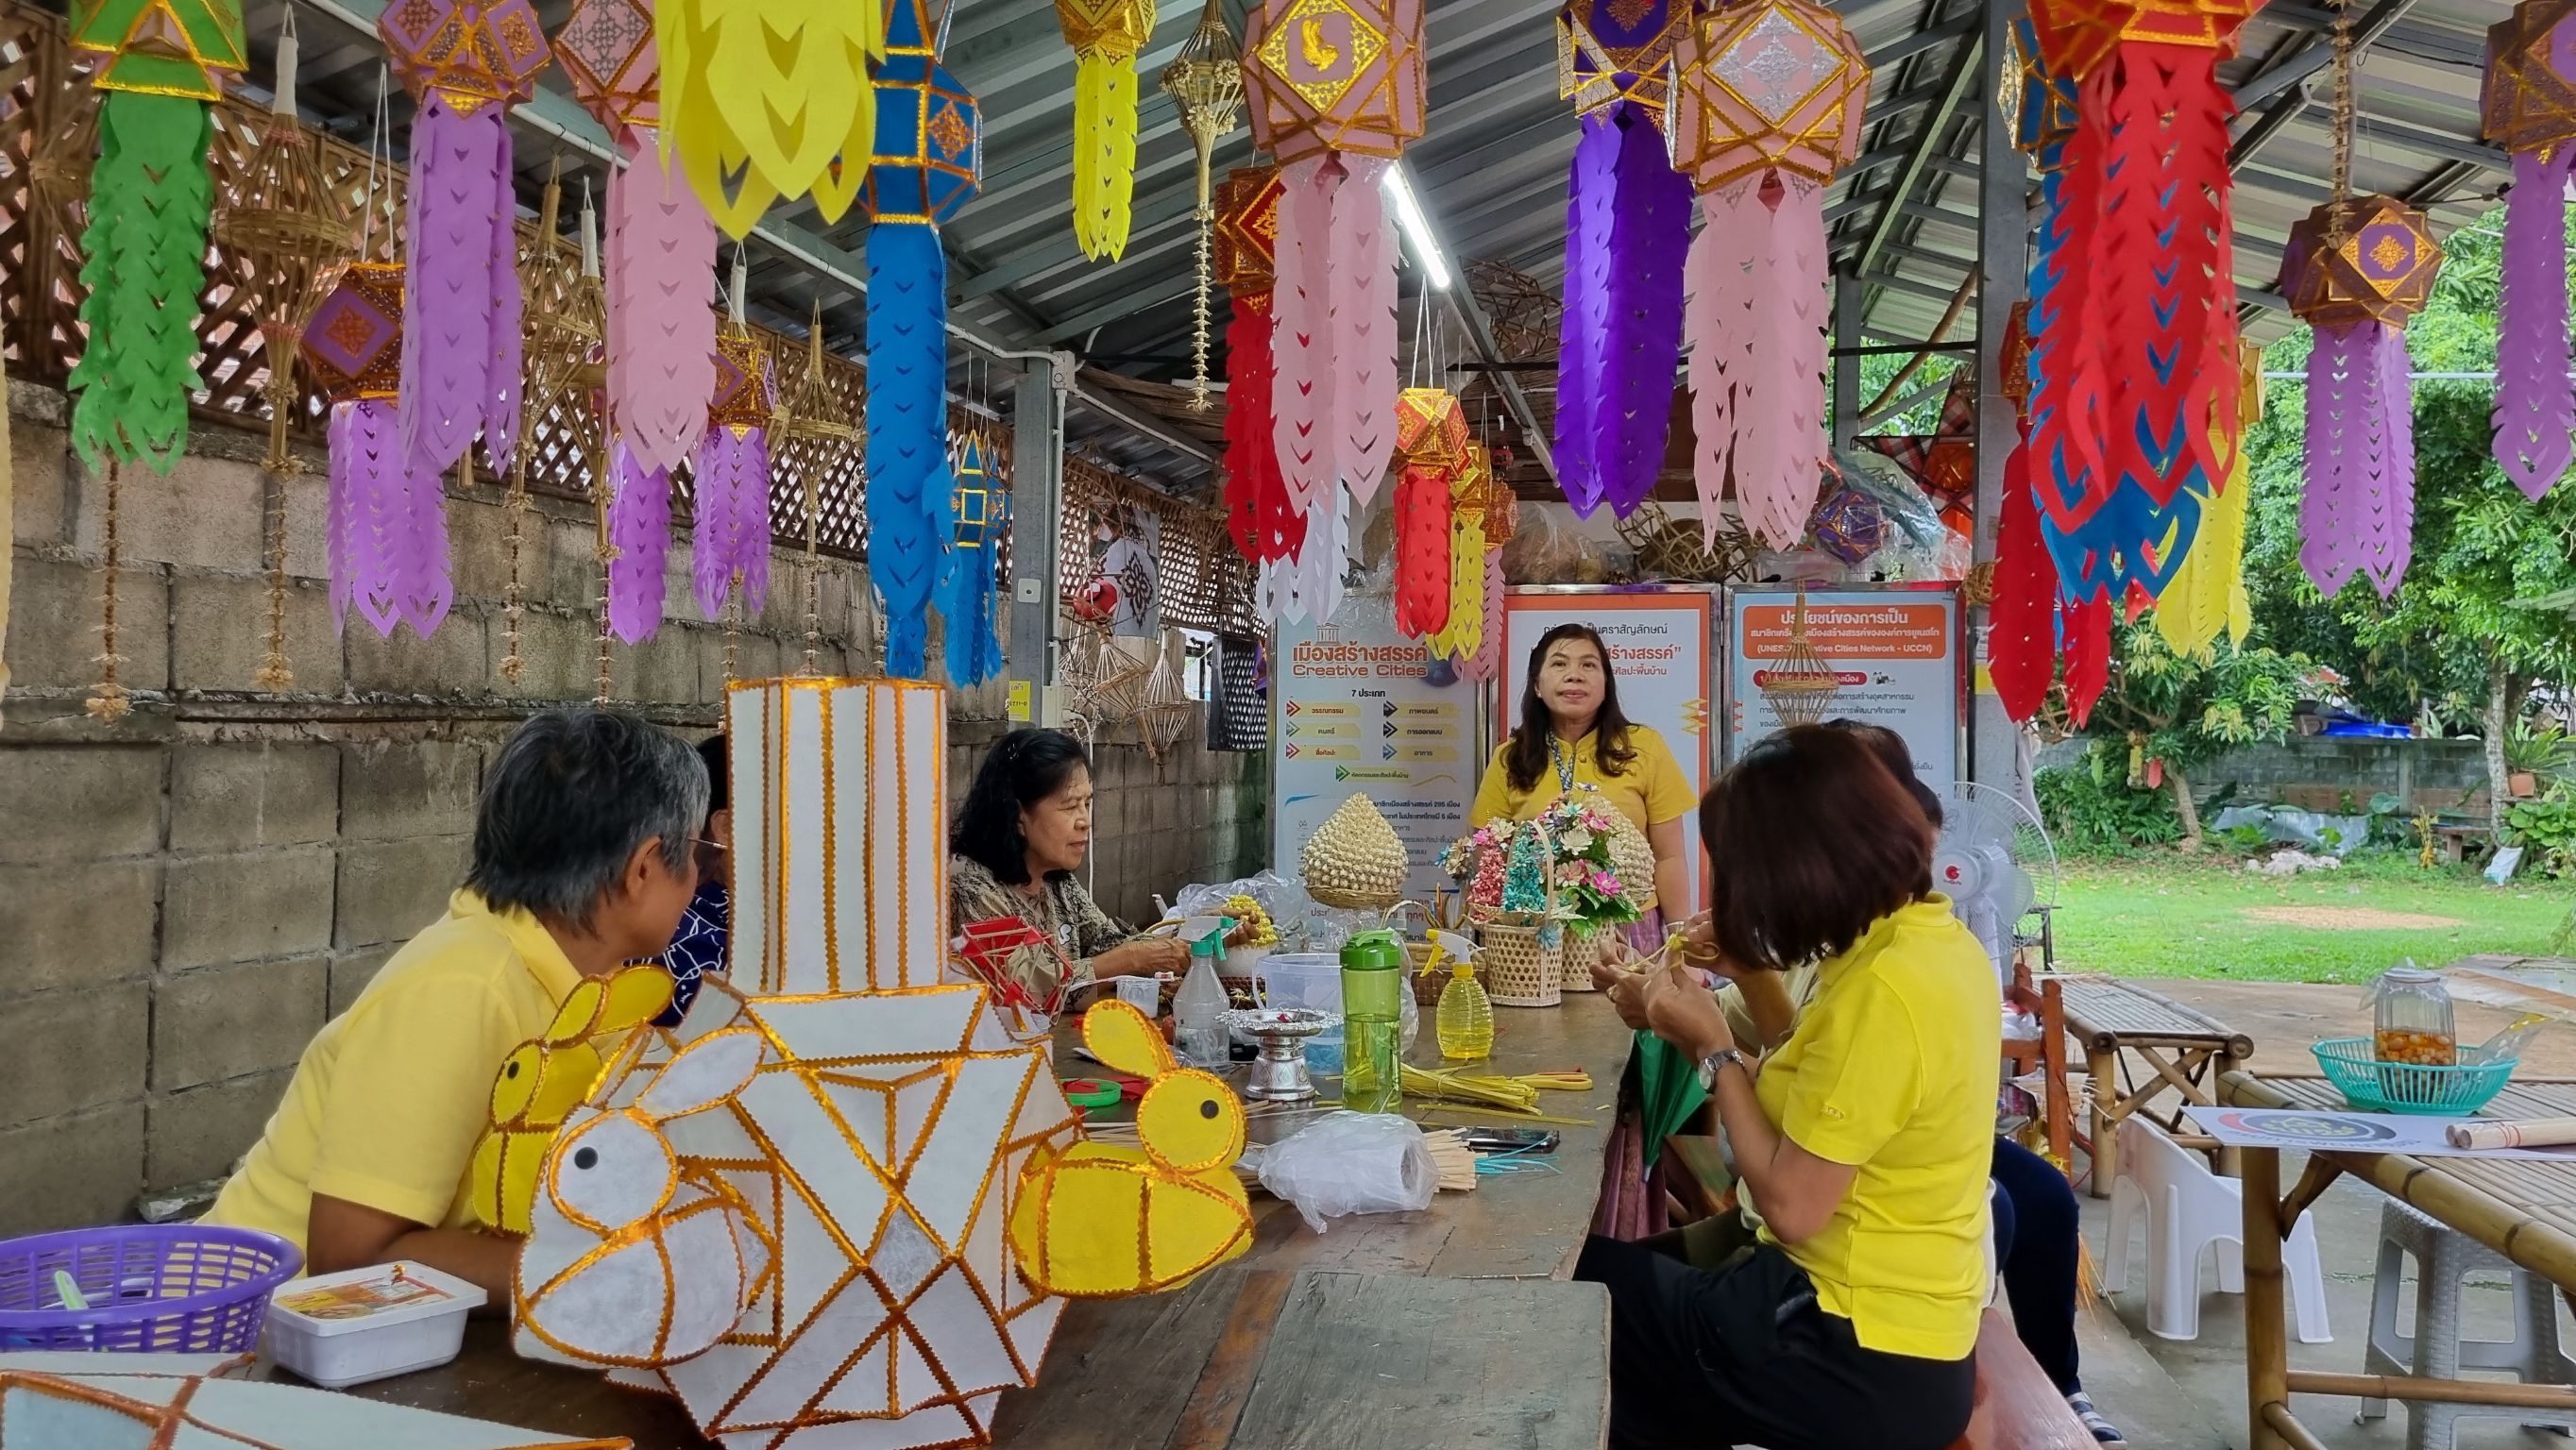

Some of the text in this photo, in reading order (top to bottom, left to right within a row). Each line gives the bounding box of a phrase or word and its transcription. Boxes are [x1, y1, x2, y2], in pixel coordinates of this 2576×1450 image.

[1781, 608, 1908, 625] ปรโยชน์ของการเป็น
[1293, 641, 1428, 662] เมืองสร้างสรรค์
[1835, 643, 1859, 652] Cities
[1860, 643, 1895, 652] Network
[1903, 643, 1933, 654] UCCN)
[1293, 664, 1428, 677] Creative Cities
[1351, 688, 1386, 698] 7 ประเภท
